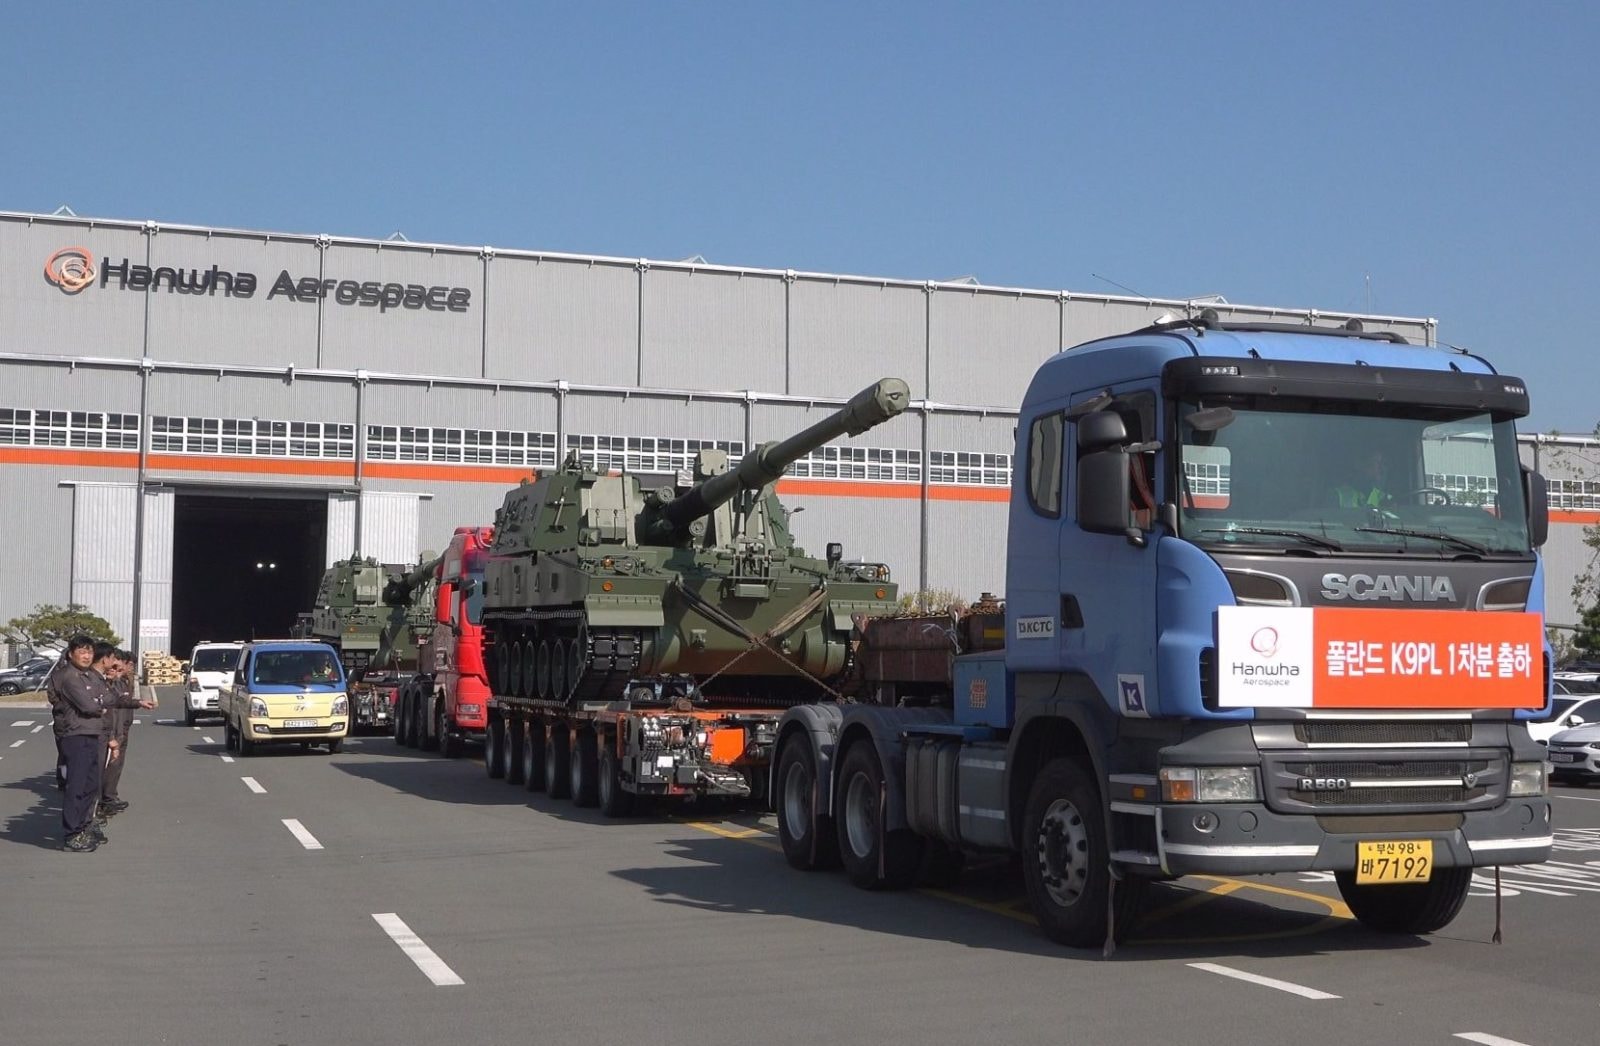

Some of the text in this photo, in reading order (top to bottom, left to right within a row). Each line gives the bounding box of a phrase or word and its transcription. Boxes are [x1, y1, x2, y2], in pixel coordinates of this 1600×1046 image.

[101, 256, 472, 312] Hanwha Aerospace
[1320, 572, 1457, 602] SCANIA
[1026, 620, 1053, 633] KCTC
[1326, 640, 1532, 678] 폴란드 K9PL 1차분 출하
[1232, 662, 1300, 676] Hanwha
[1243, 678, 1290, 687] Aerospace
[1127, 688, 1139, 706] K
[1302, 778, 1347, 790] R 560
[1376, 843, 1415, 855] 부산 98
[1361, 856, 1428, 880] 바 7192
